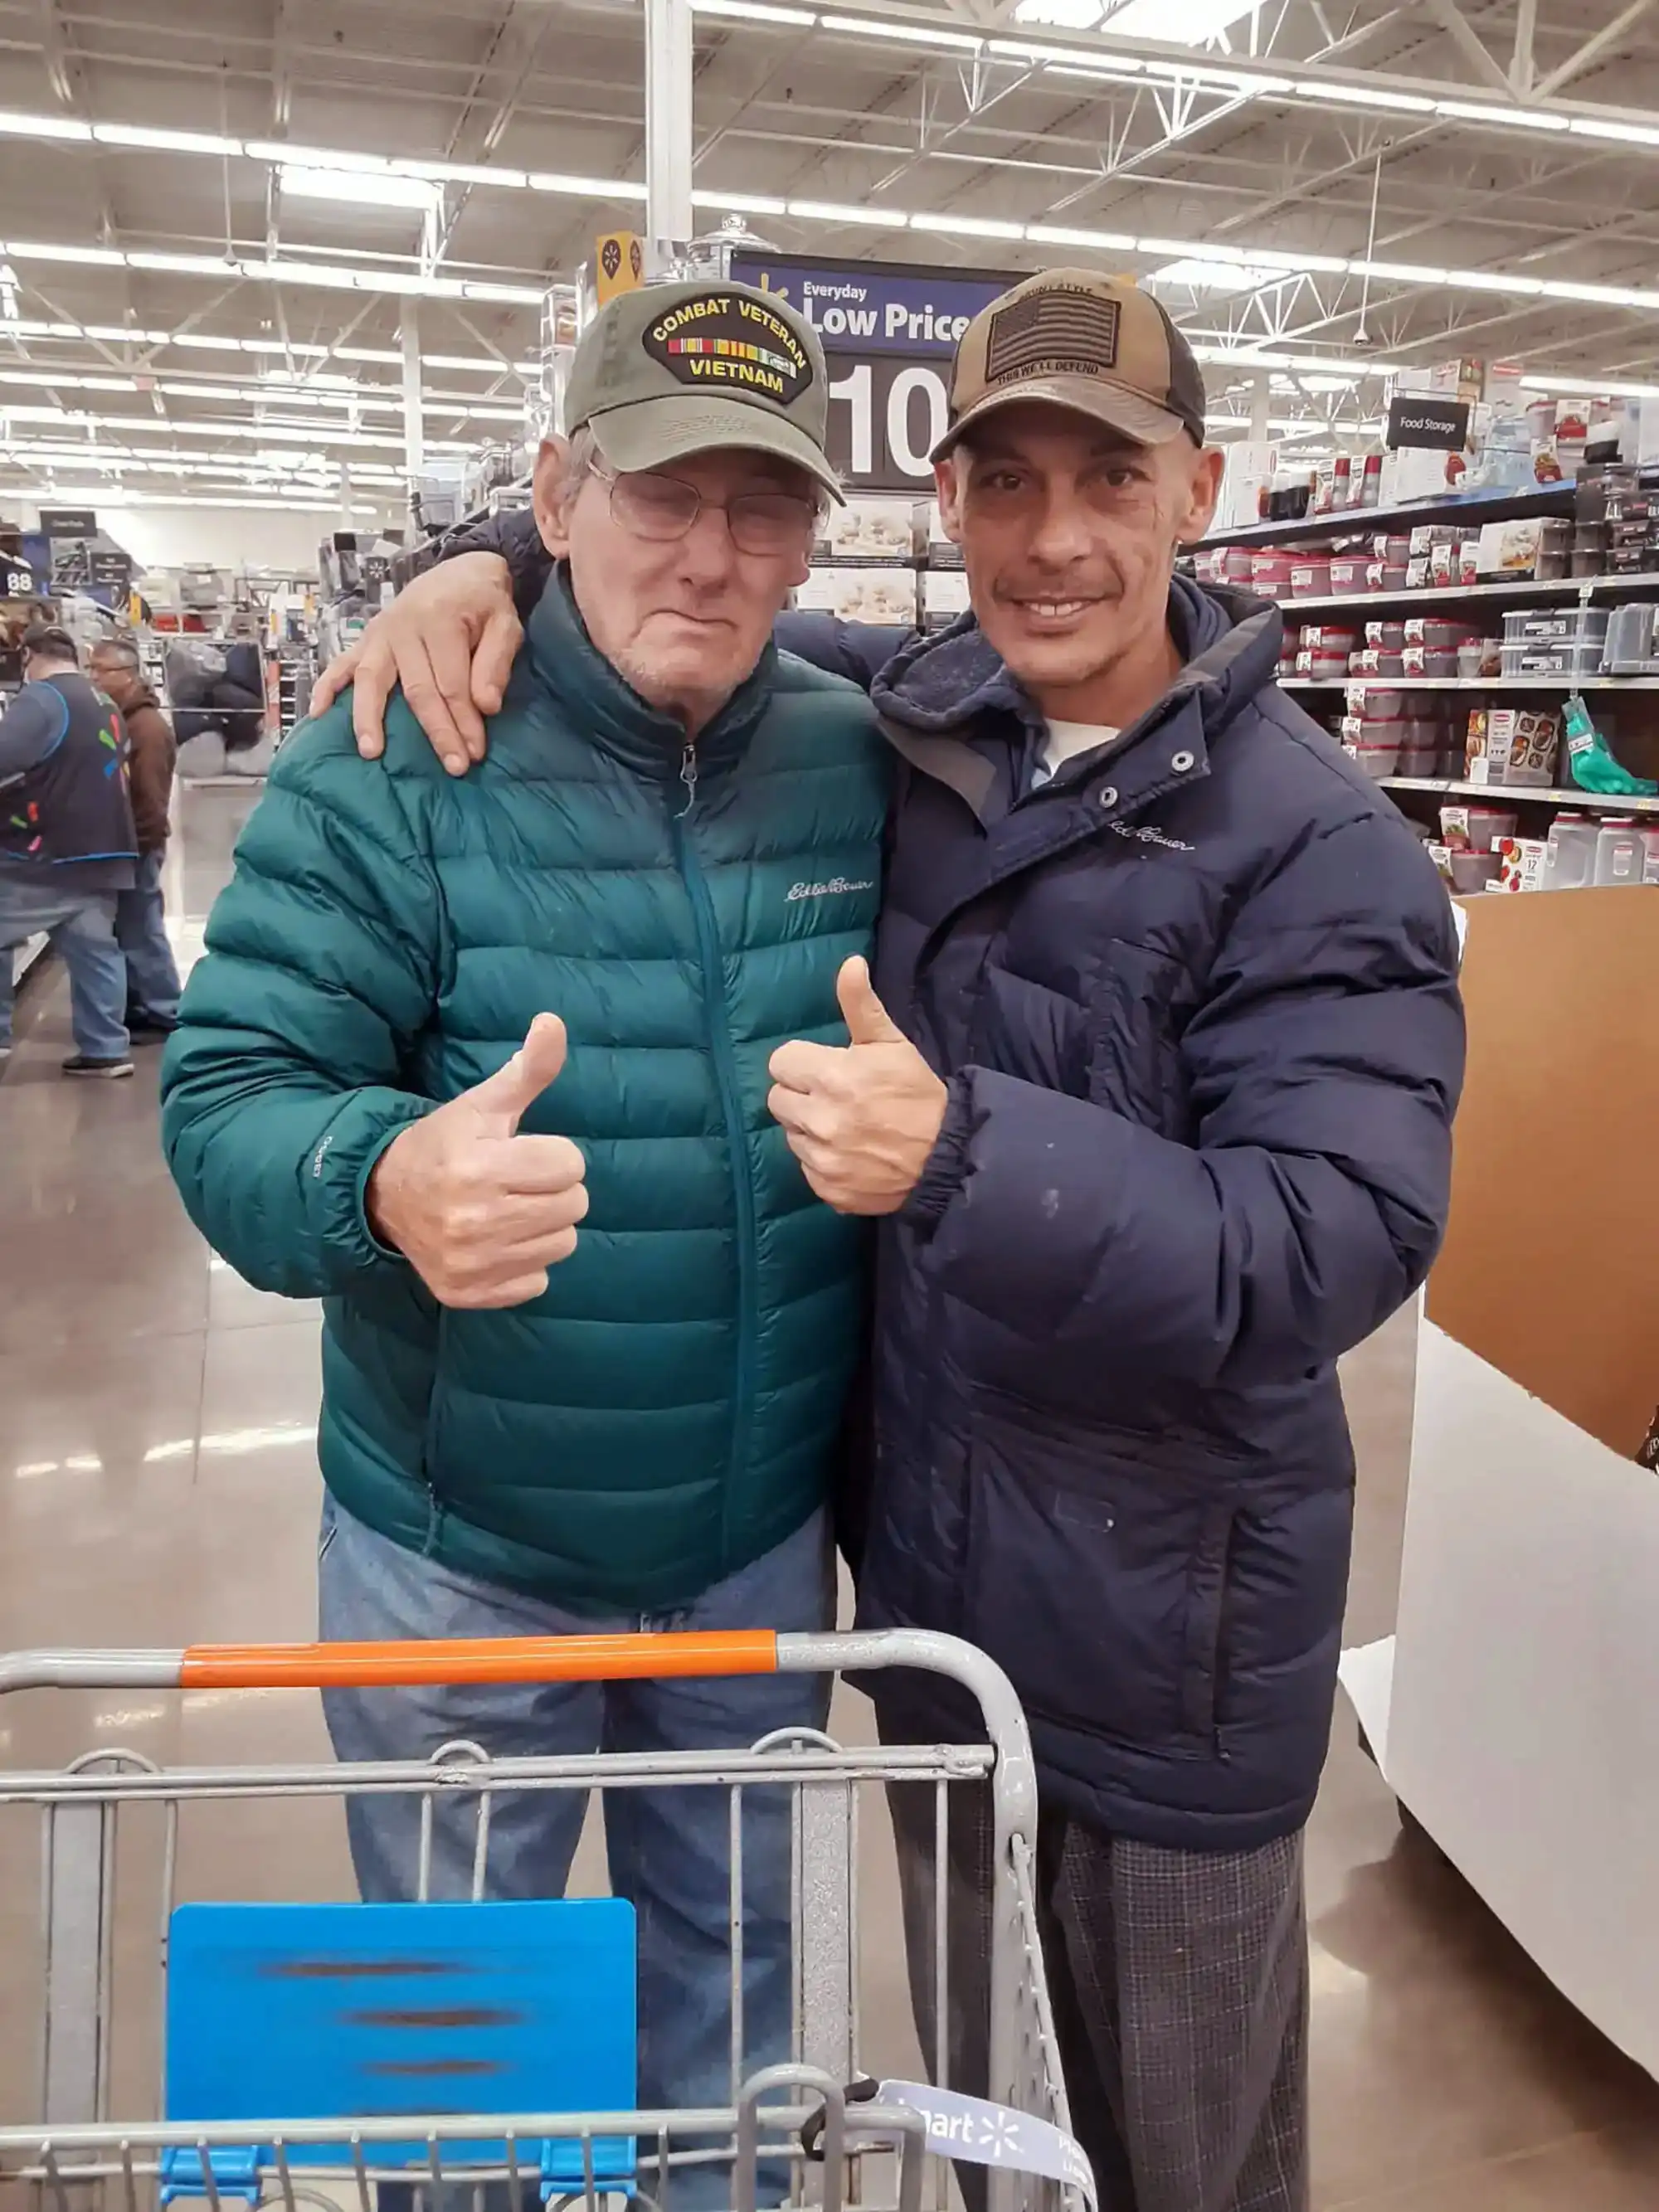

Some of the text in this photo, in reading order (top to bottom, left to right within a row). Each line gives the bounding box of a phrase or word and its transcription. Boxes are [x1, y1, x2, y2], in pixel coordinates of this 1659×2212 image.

[804, 281, 867, 301] Everyday
[653, 299, 807, 369] COMBAT VETERAN
[803, 298, 971, 342] Low Price
[689, 358, 784, 394] VIETNAM
[830, 365, 948, 477] 10
[1400, 416, 1457, 434] Food Storage
